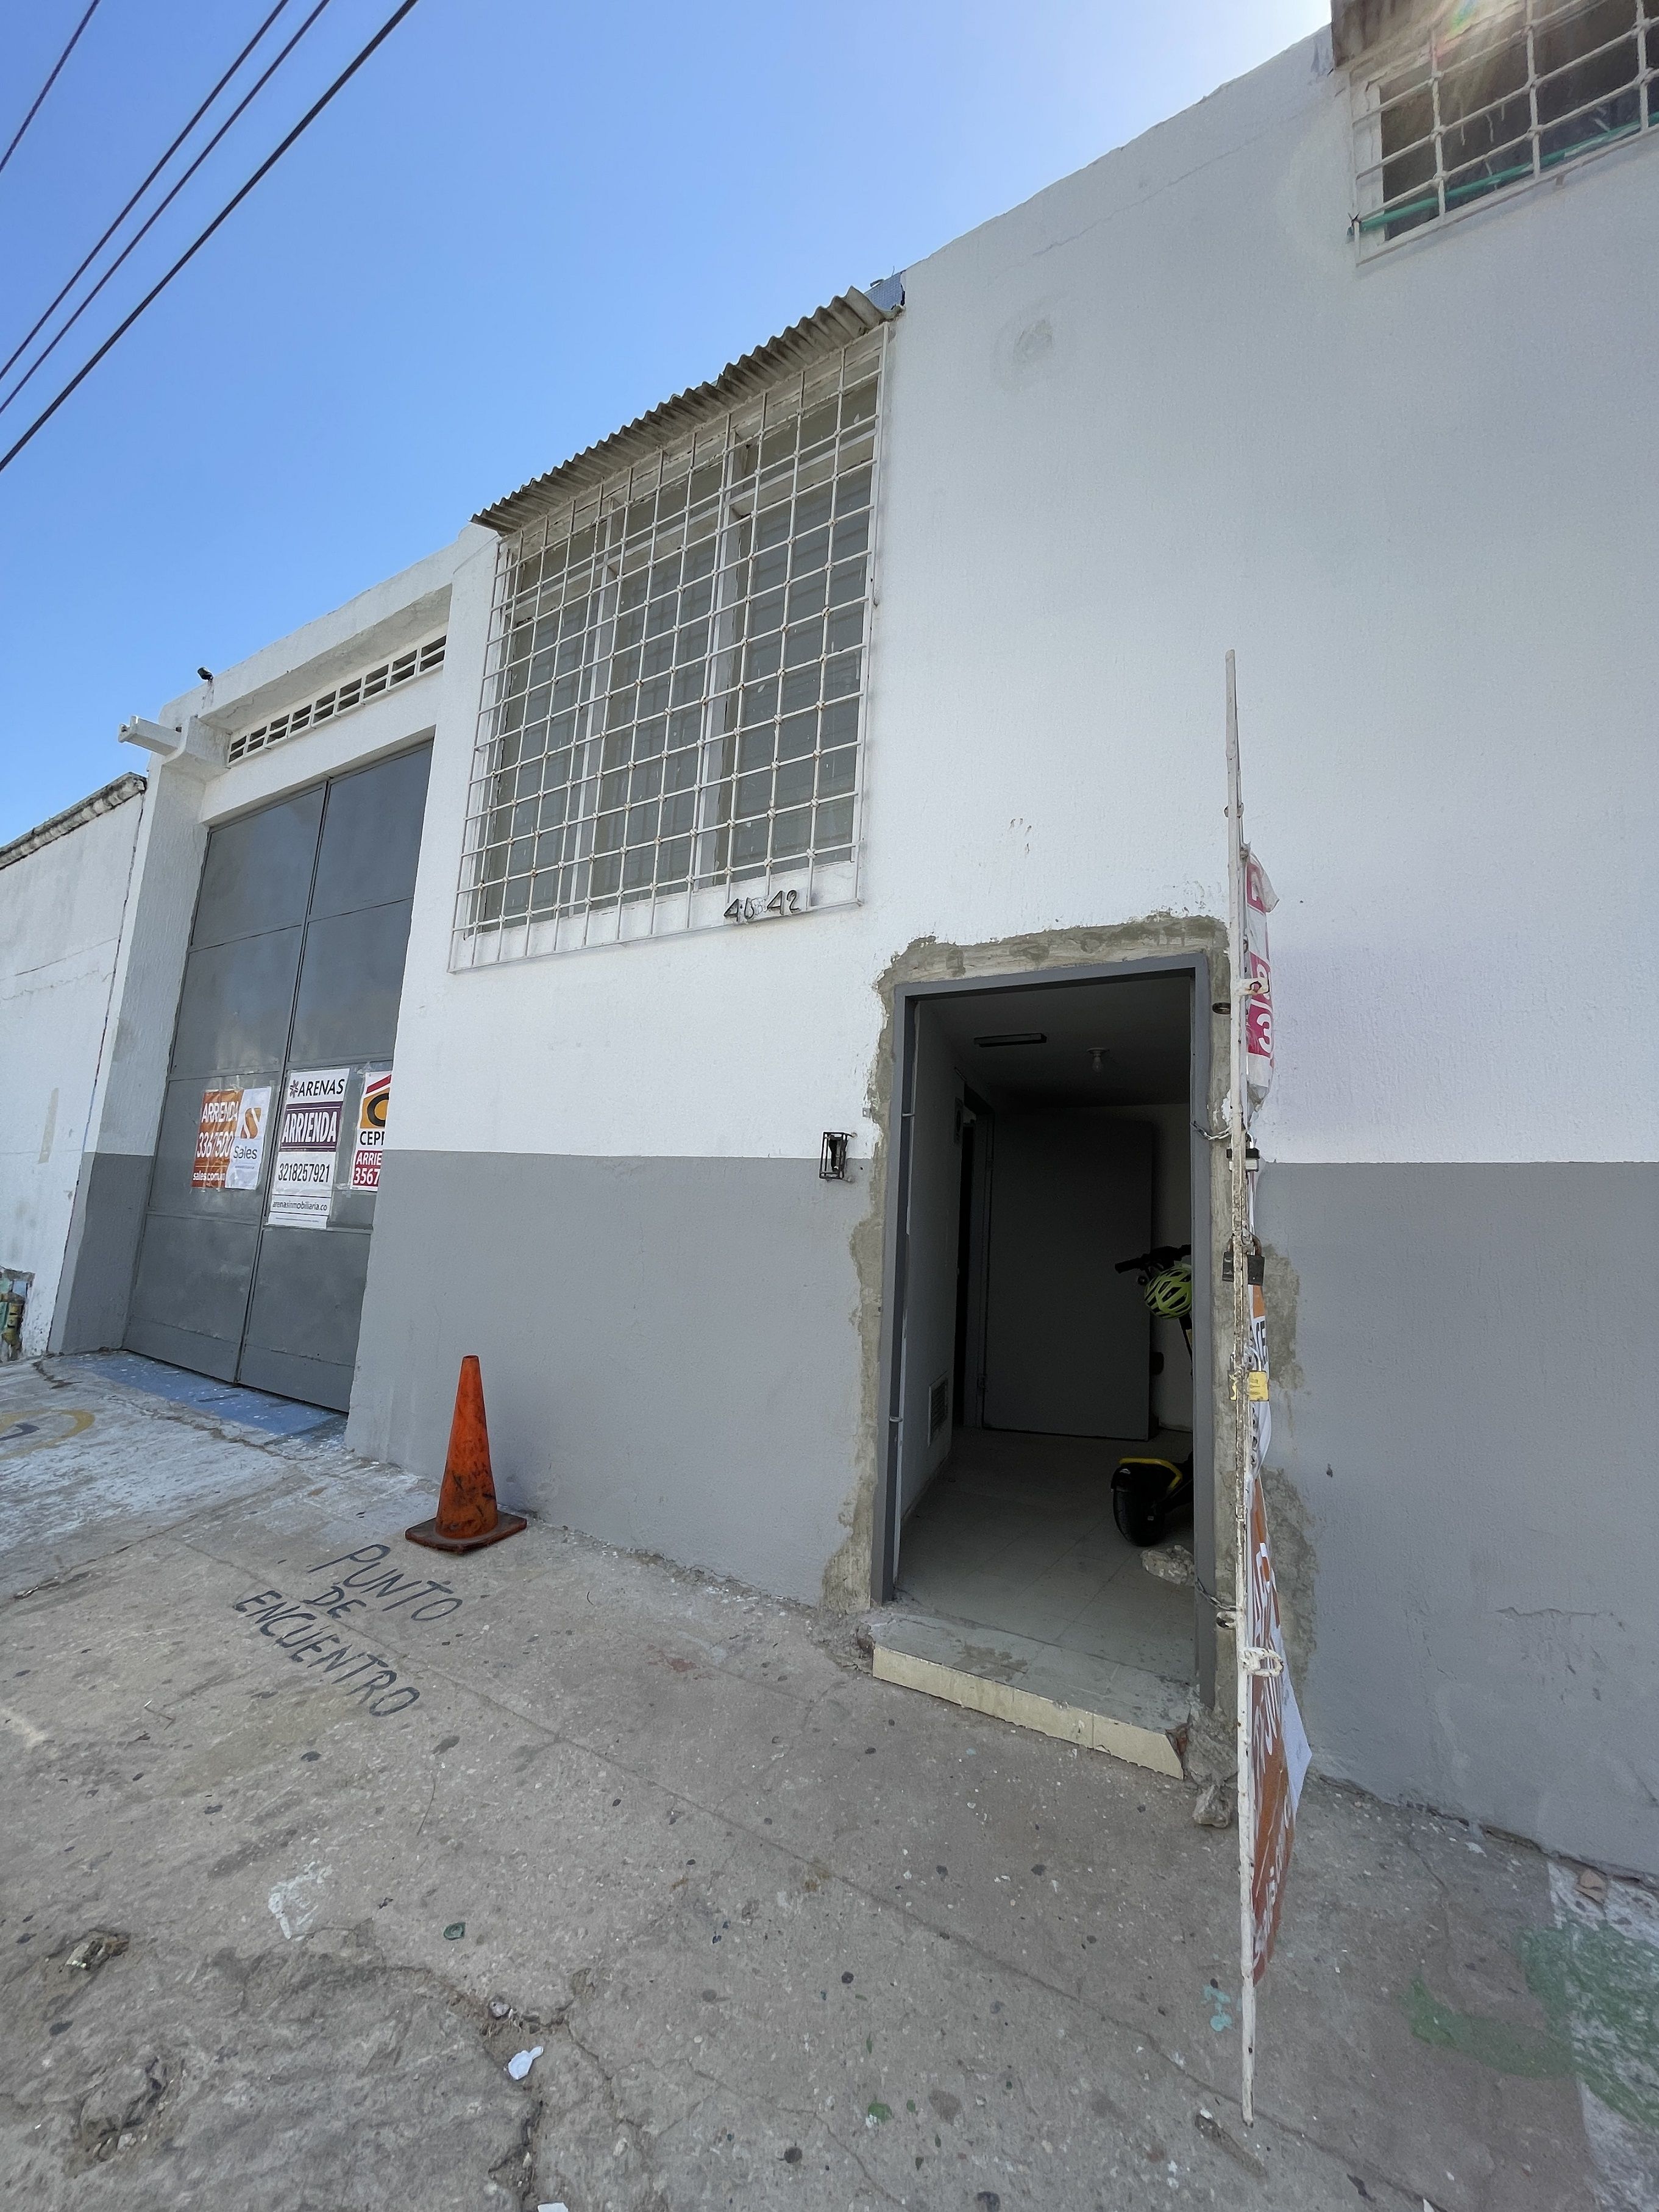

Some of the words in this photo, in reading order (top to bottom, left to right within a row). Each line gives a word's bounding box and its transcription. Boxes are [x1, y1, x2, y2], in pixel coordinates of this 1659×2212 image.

[767, 889, 800, 915] 42
[298, 1078, 346, 1097] ARENAS
[281, 1111, 338, 1143] ARRIENDA
[233, 1145, 258, 1160] Sales
[278, 1163, 330, 1184] 3218257921
[307, 1543, 463, 1622] PUNTO
[301, 1585, 367, 1619] DE
[233, 1590, 421, 1717] ENCUENTRO
